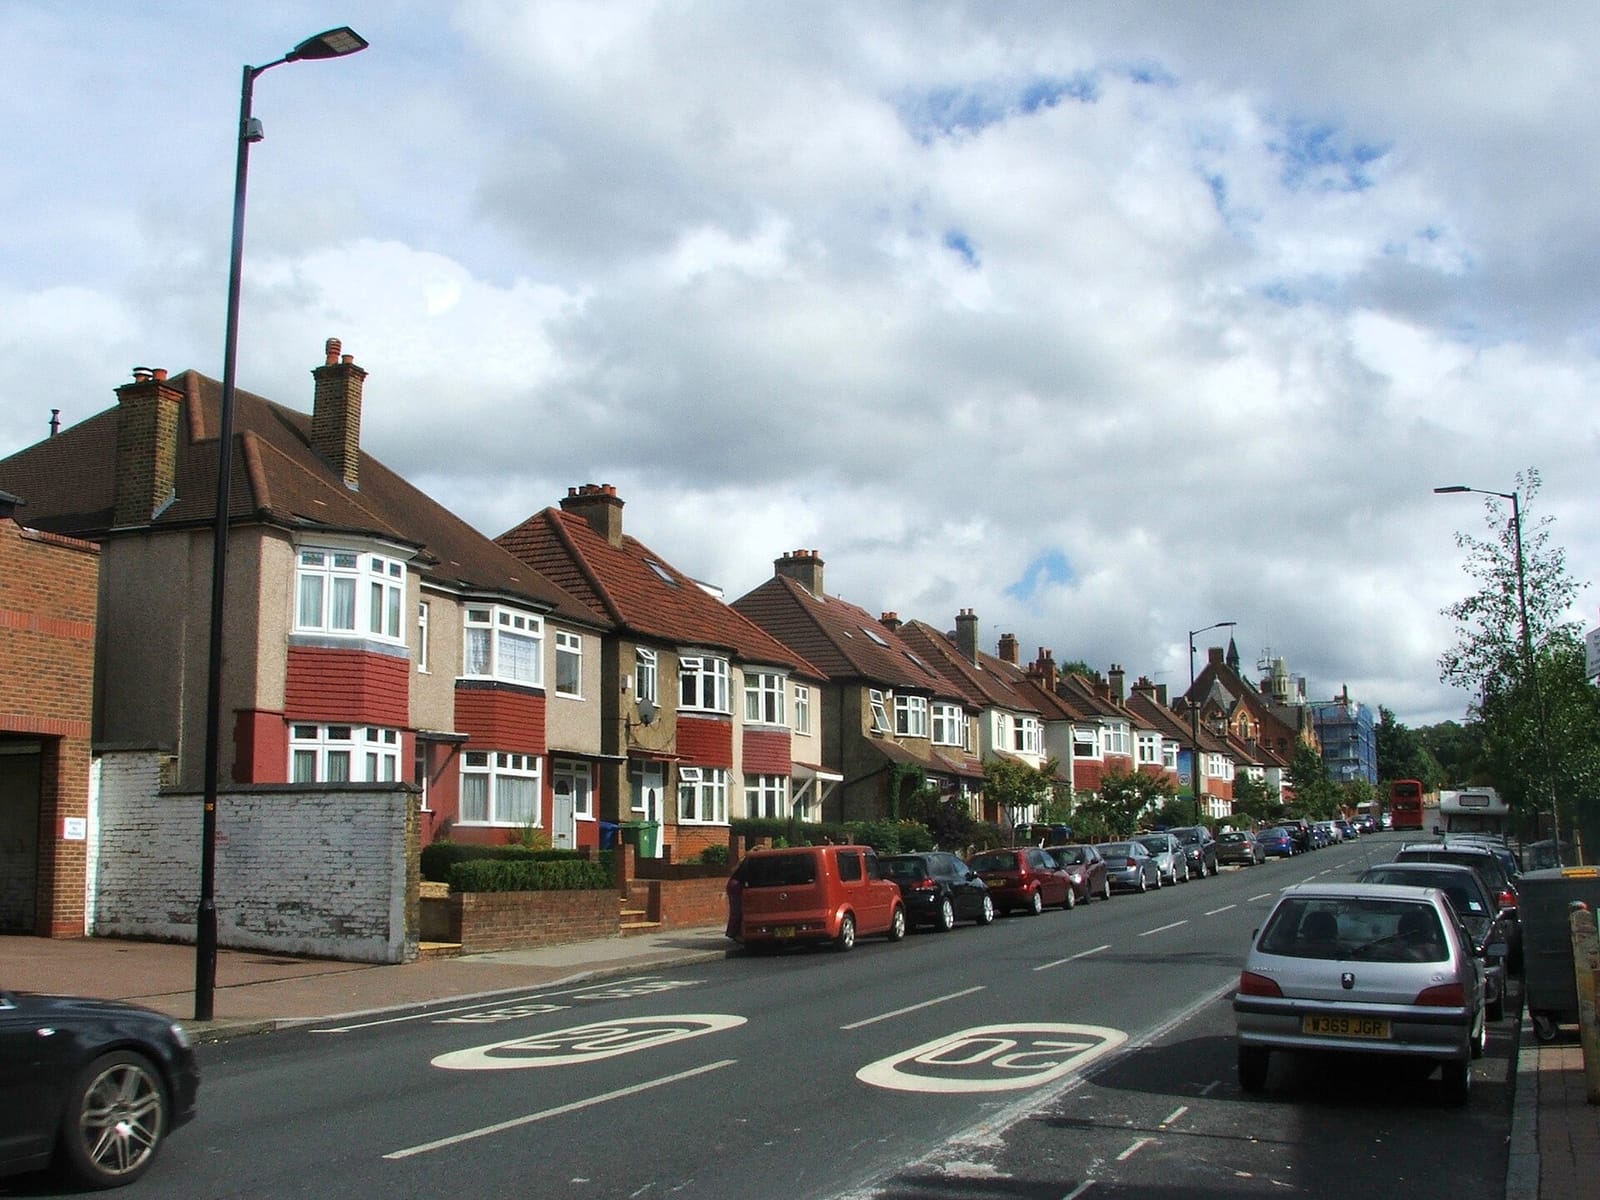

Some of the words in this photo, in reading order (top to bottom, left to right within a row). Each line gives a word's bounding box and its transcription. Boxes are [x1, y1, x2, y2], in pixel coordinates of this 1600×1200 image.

[1311, 1017, 1350, 1033] W369
[1353, 1018, 1383, 1036] JGR
[499, 1027, 692, 1050] 20
[914, 1038, 1094, 1069] 20
